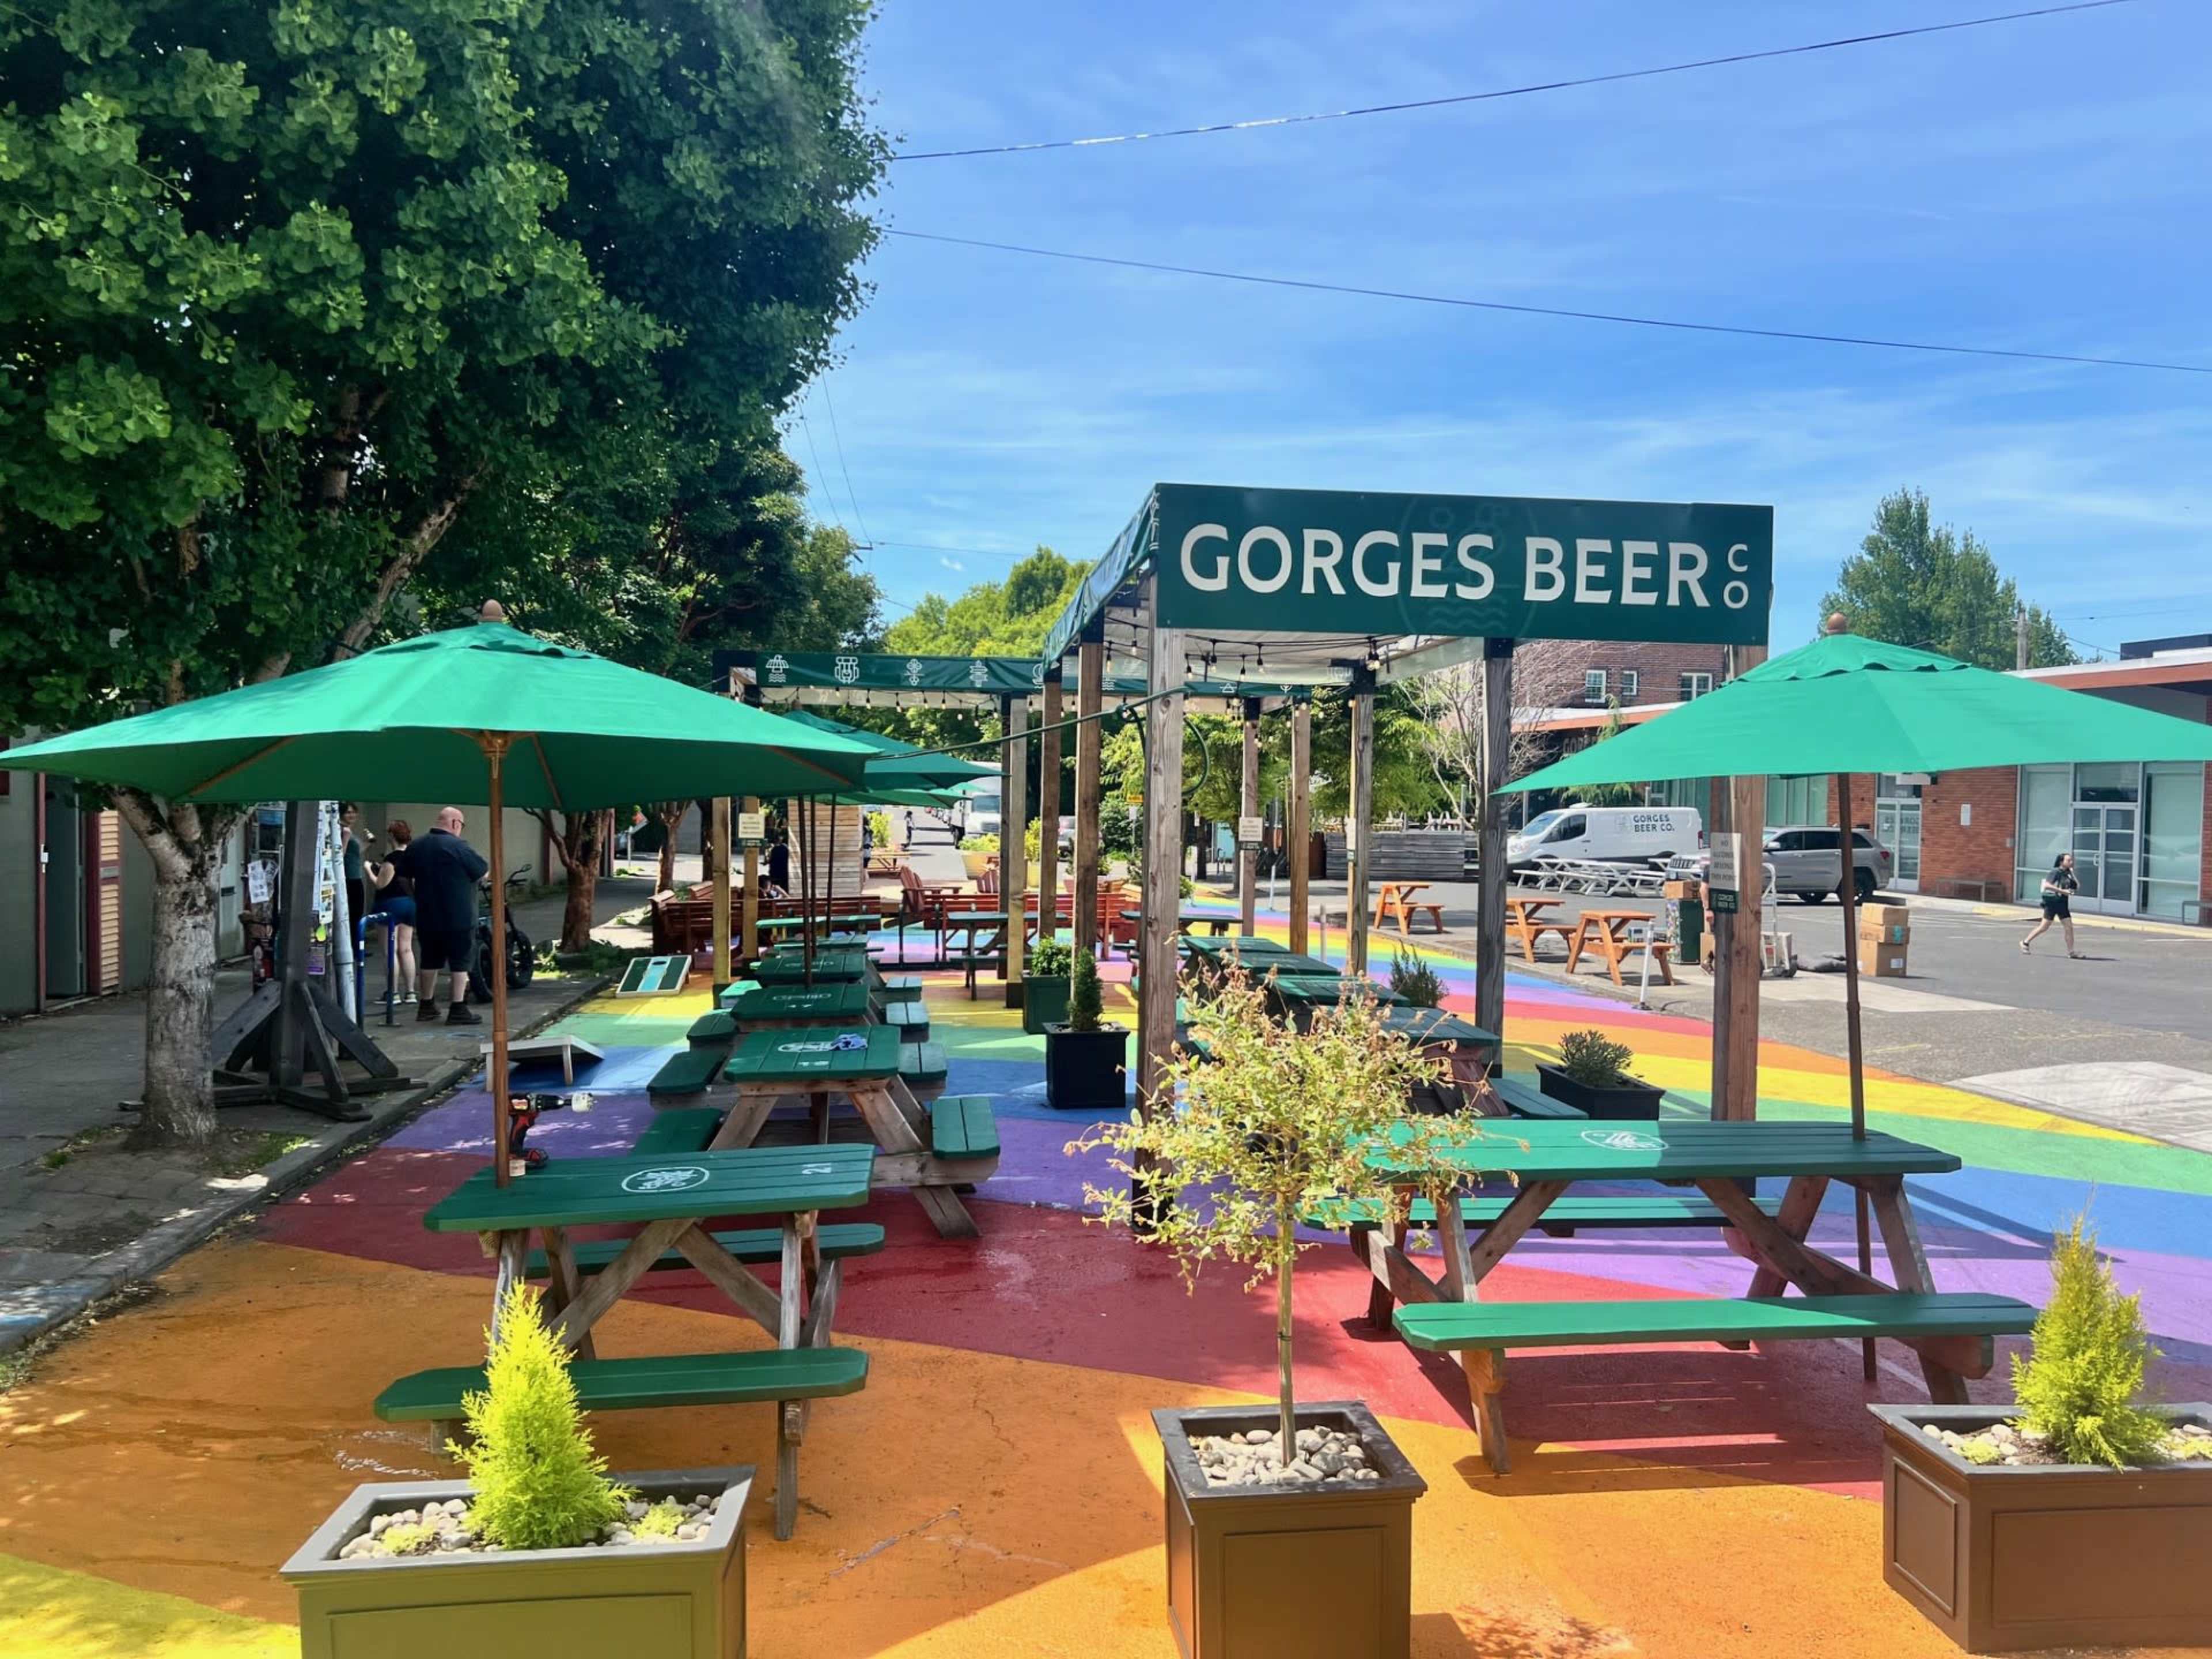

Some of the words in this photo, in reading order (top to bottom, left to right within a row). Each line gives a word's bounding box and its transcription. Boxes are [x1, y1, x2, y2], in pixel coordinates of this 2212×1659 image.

[1181, 524, 1495, 600] GORGES
[1524, 537, 1710, 607] BEER
[1633, 814, 1670, 823] GORGES
[1634, 824, 1657, 832] BEER
[1660, 823, 1675, 831] CO.
